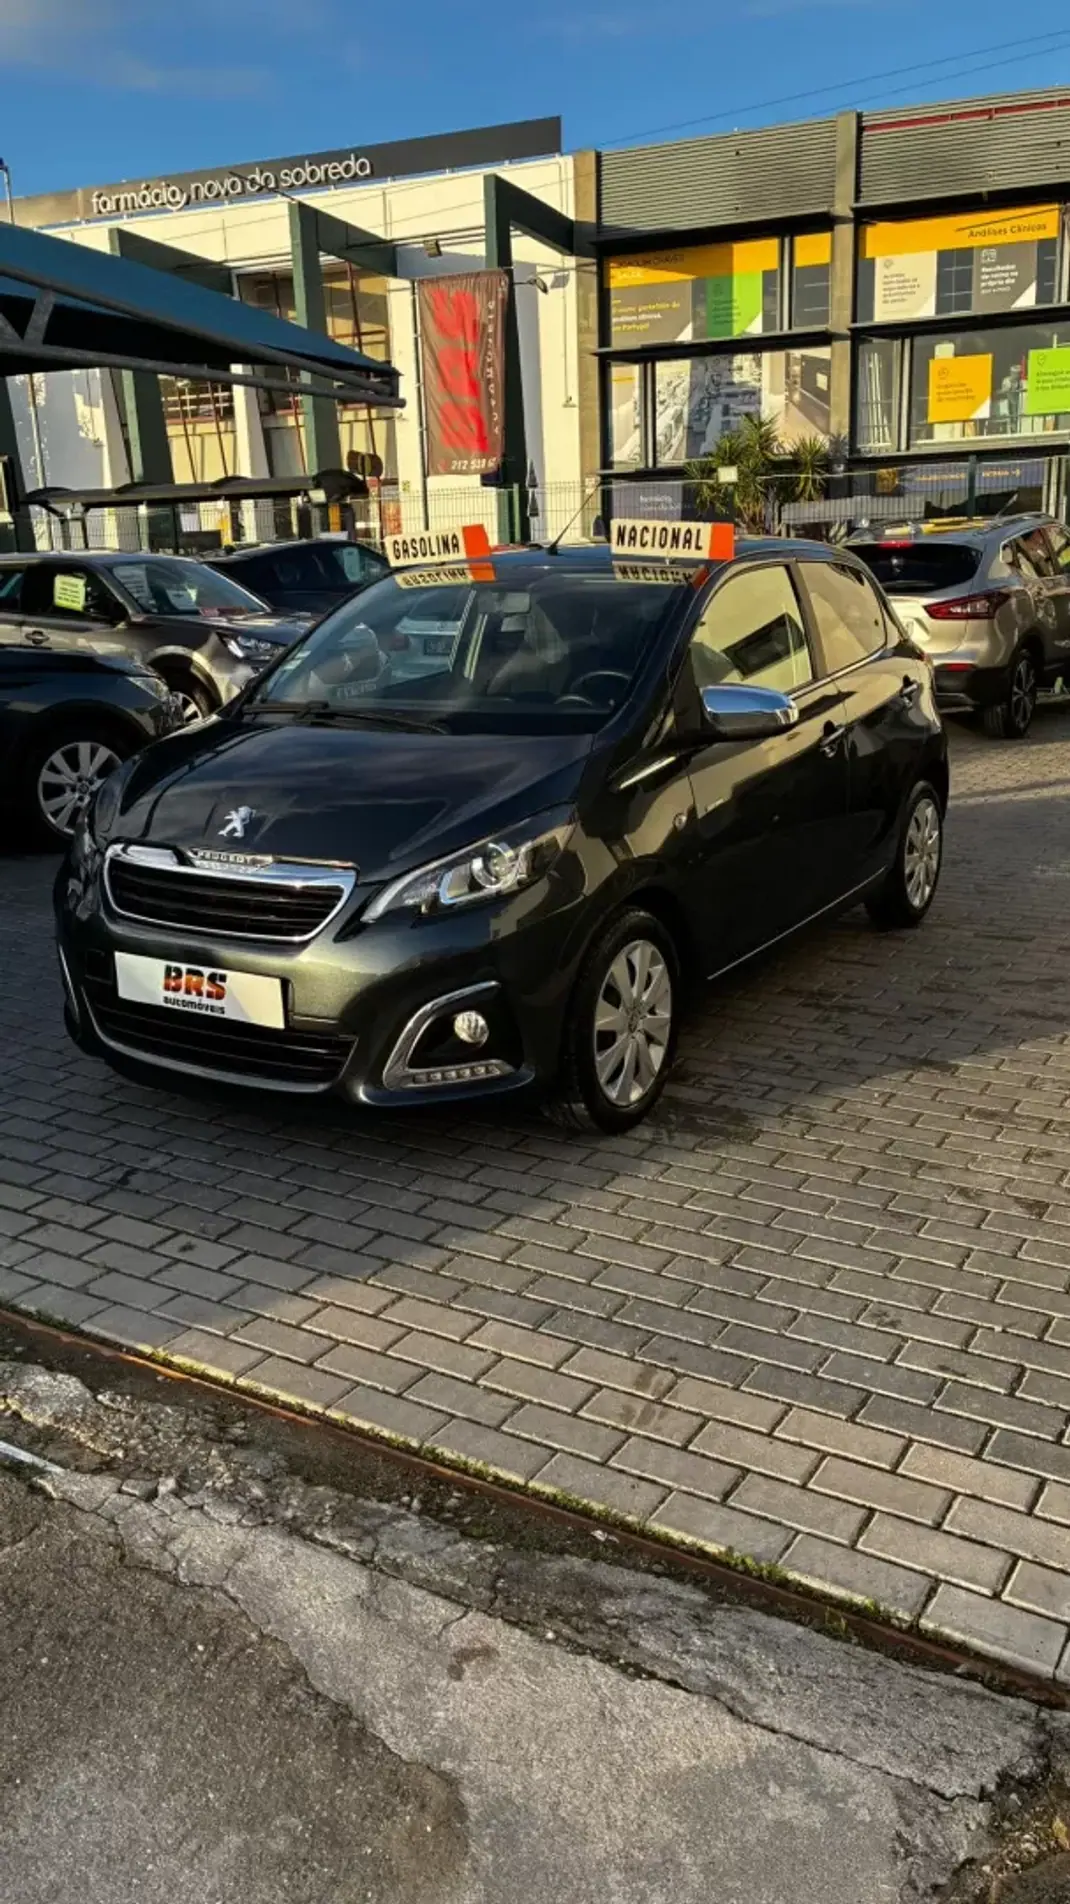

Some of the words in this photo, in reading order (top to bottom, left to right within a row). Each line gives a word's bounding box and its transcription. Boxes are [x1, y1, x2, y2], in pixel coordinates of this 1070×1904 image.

[92, 183, 184, 214] farmácia
[191, 179, 242, 201] nova
[247, 167, 275, 191] da
[281, 153, 372, 187] sobreda
[392, 532, 461, 561] GASOLINA
[616, 525, 703, 551] NACIONAL
[163, 964, 228, 1001] BRS
